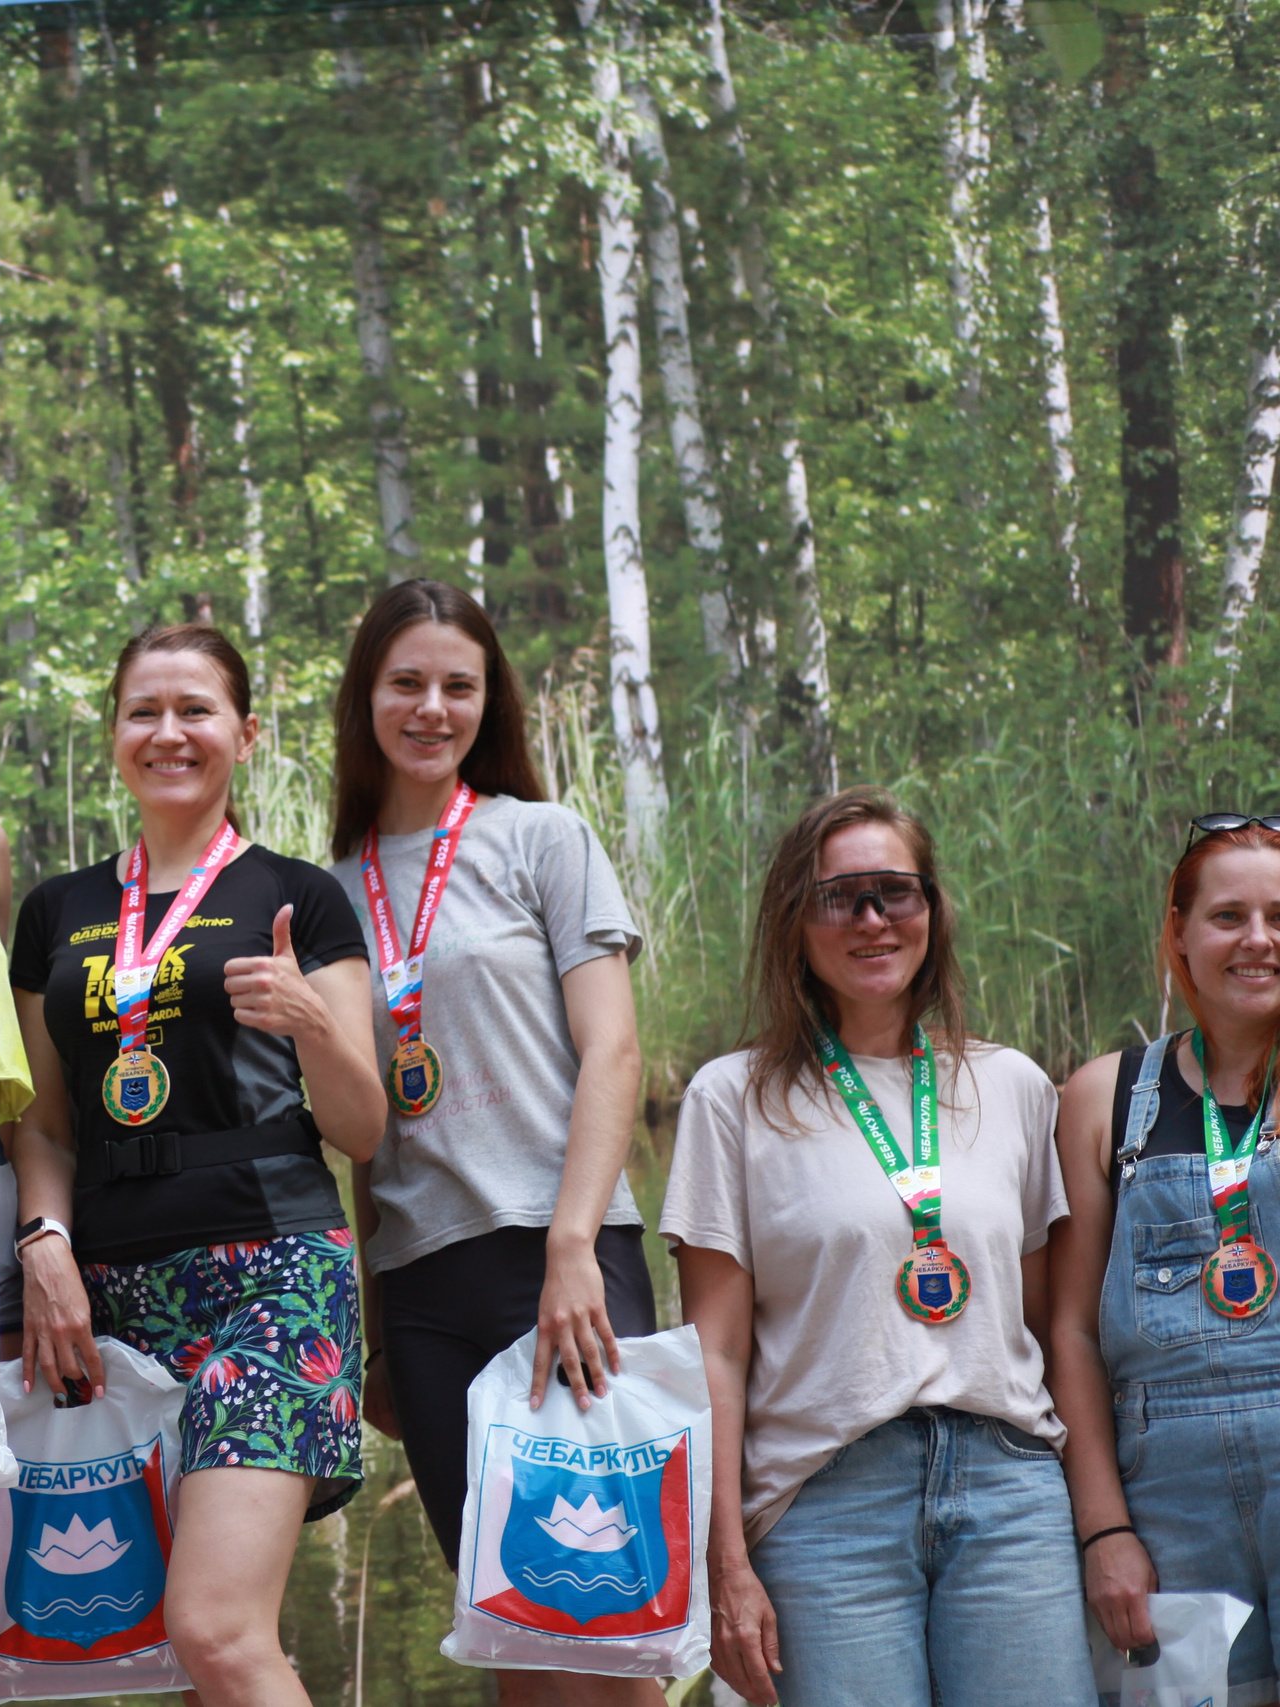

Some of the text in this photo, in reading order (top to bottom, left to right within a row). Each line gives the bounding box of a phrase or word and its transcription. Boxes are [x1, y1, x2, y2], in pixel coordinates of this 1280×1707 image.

[129, 886, 140, 907] 2024
[147, 904, 187, 960] ЧЕБАРКУЛЬ
[185, 875, 206, 899] 2024
[371, 866, 395, 963] ЧЕБАРКУЛЬ 2024
[414, 838, 451, 948] ЧЕБАРКУЛЬ 2024
[124, 912, 137, 967] ЧЕБАРКУЛЬ
[92, 1020, 118, 1033] RIVA
[921, 1060, 930, 1086] 2024
[857, 1101, 896, 1167] ЧЕБАРКУЛЬ
[921, 1094, 930, 1161] ЧЕБАРКУЛЬ
[914, 1265, 953, 1273] ЧЕБАРКУЛЬ
[1220, 1259, 1259, 1270] ЧЕБАРКУЛЬ
